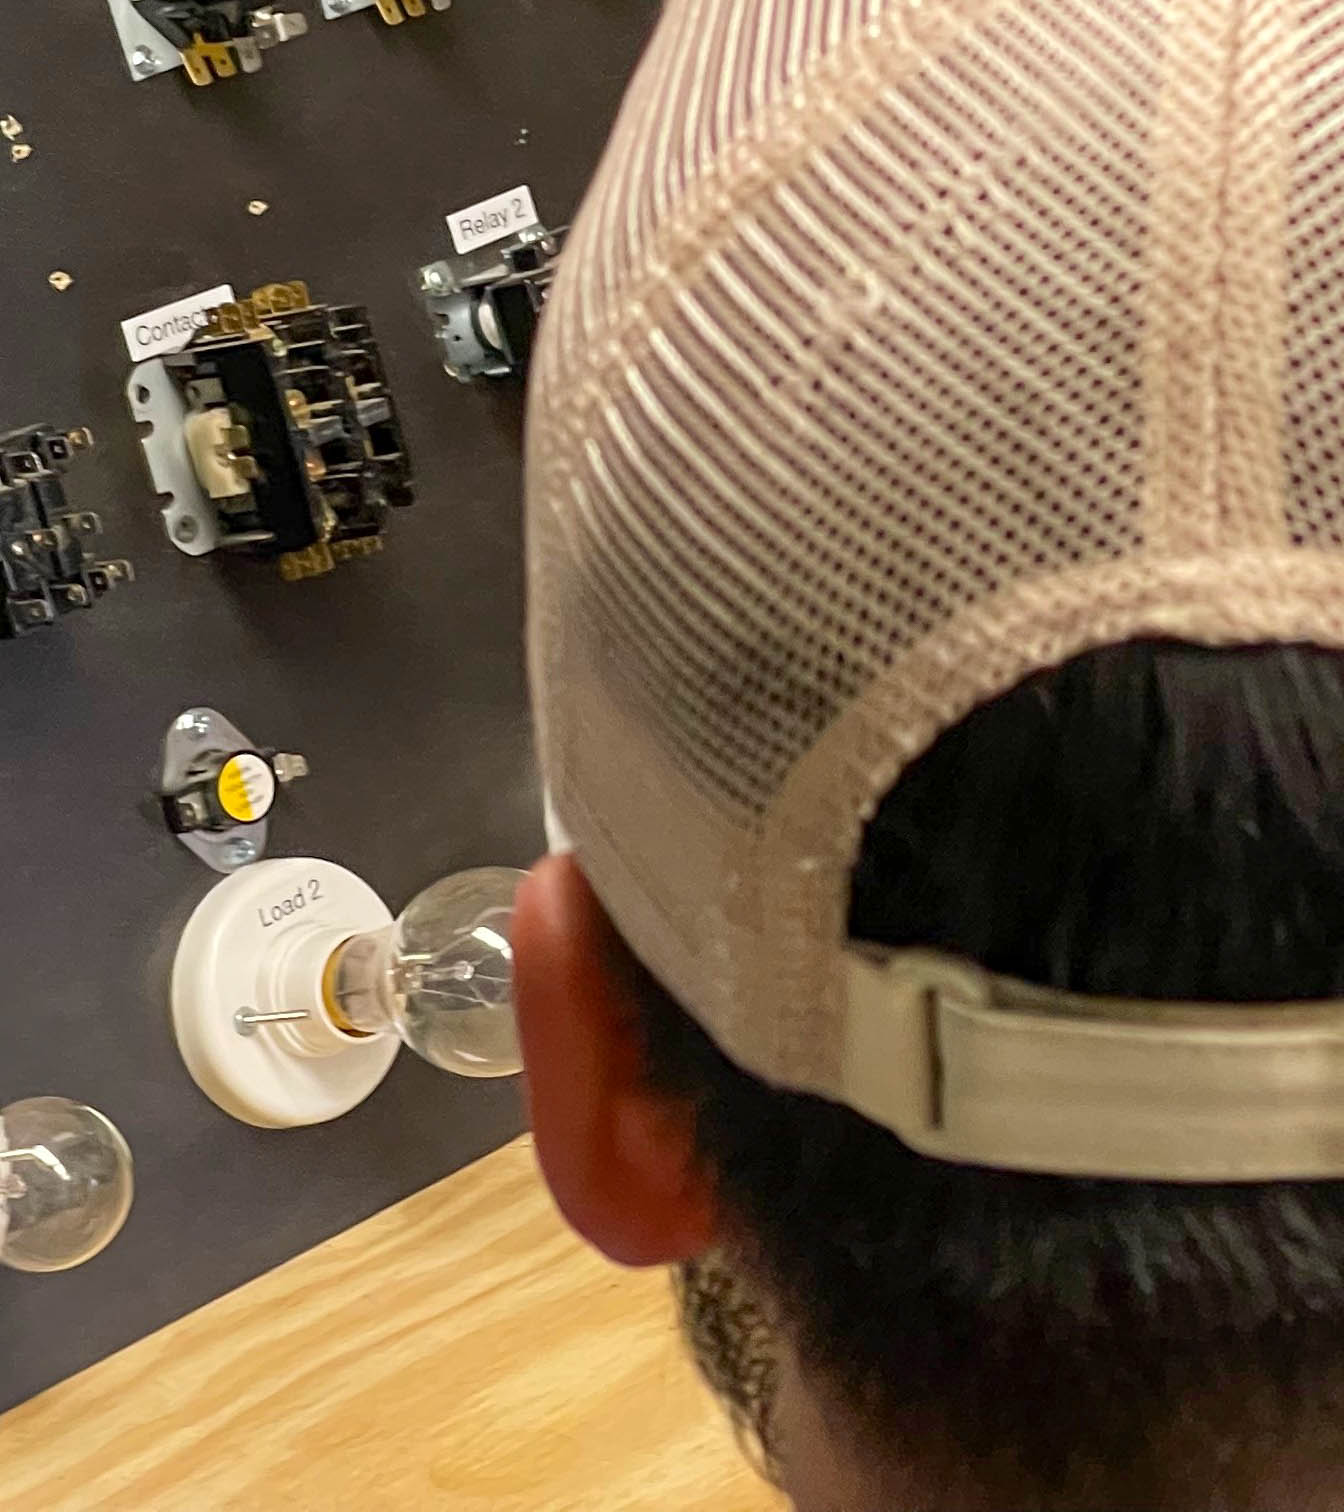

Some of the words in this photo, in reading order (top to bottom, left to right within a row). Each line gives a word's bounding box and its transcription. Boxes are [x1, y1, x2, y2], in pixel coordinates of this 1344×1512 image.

[459, 207, 509, 241] Relay
[511, 197, 527, 219] 2
[135, 310, 206, 346] Contac
[258, 886, 307, 927] Load
[307, 878, 325, 901] 2
